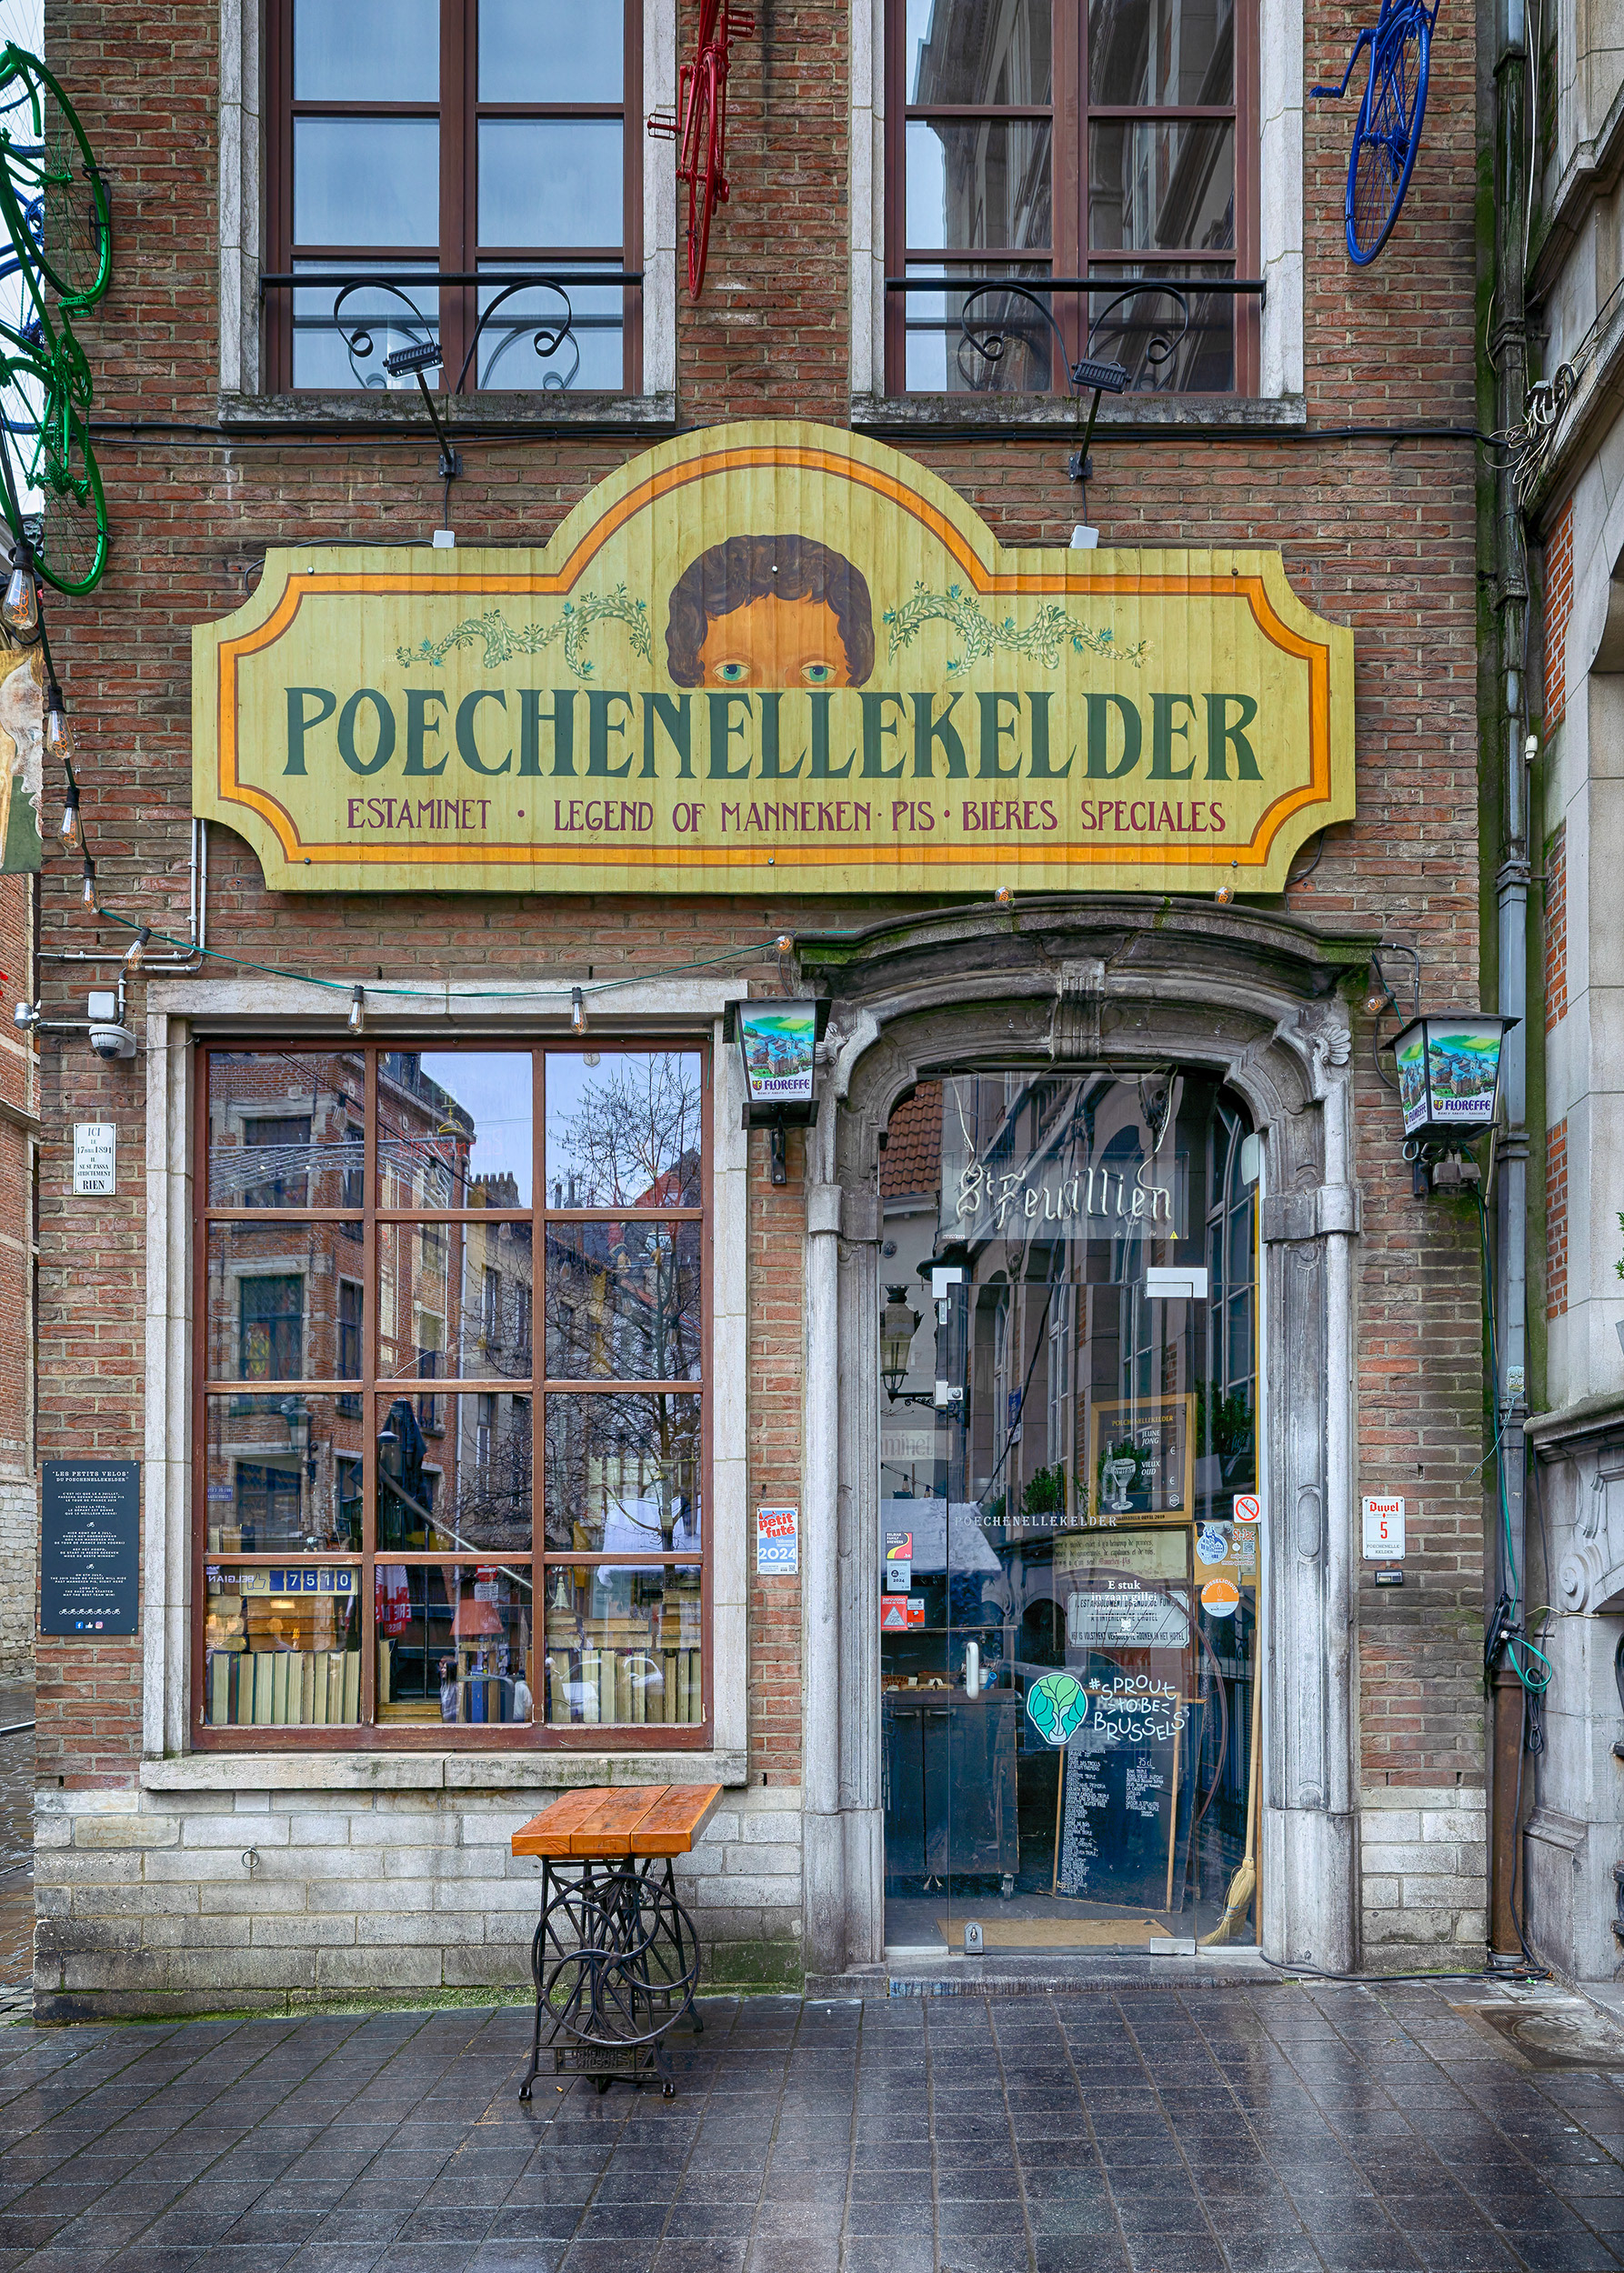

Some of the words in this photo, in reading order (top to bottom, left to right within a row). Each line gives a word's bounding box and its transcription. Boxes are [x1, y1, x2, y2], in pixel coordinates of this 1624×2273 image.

[283, 686, 1265, 781] POECHENELLEKELDER
[346, 798, 491, 829] ESTAMINET
[554, 800, 653, 831] LEGEND
[673, 803, 706, 832] OF
[721, 801, 871, 831] MANNEKEN
[892, 801, 935, 831] PIS
[764, 1079, 810, 1091] FLOREFFE
[1445, 1099, 1491, 1111] FLOREFFE
[87, 1127, 101, 1136] ICI
[95, 1146, 112, 1154] 1891
[83, 1180, 105, 1190] RIEN
[1141, 1429, 1161, 1438] JEUNE
[881, 1435, 933, 1456] minet
[1141, 1437, 1159, 1447] JONG
[1369, 1501, 1398, 1512] Duvel
[758, 1513, 793, 1531] petit
[955, 1516, 1118, 1527] POECHENELLEKELDER
[766, 1524, 795, 1538] futé
[1380, 1521, 1388, 1539] 5
[759, 1547, 796, 1560] 2024
[1108, 1581, 1115, 1590] E
[1118, 1580, 1141, 1590] stuk
[1201, 1578, 1238, 1596] BRUSSELICIOUS
[1091, 1592, 1102, 1601] in
[1094, 1712, 1185, 1742] BRUSSELS
